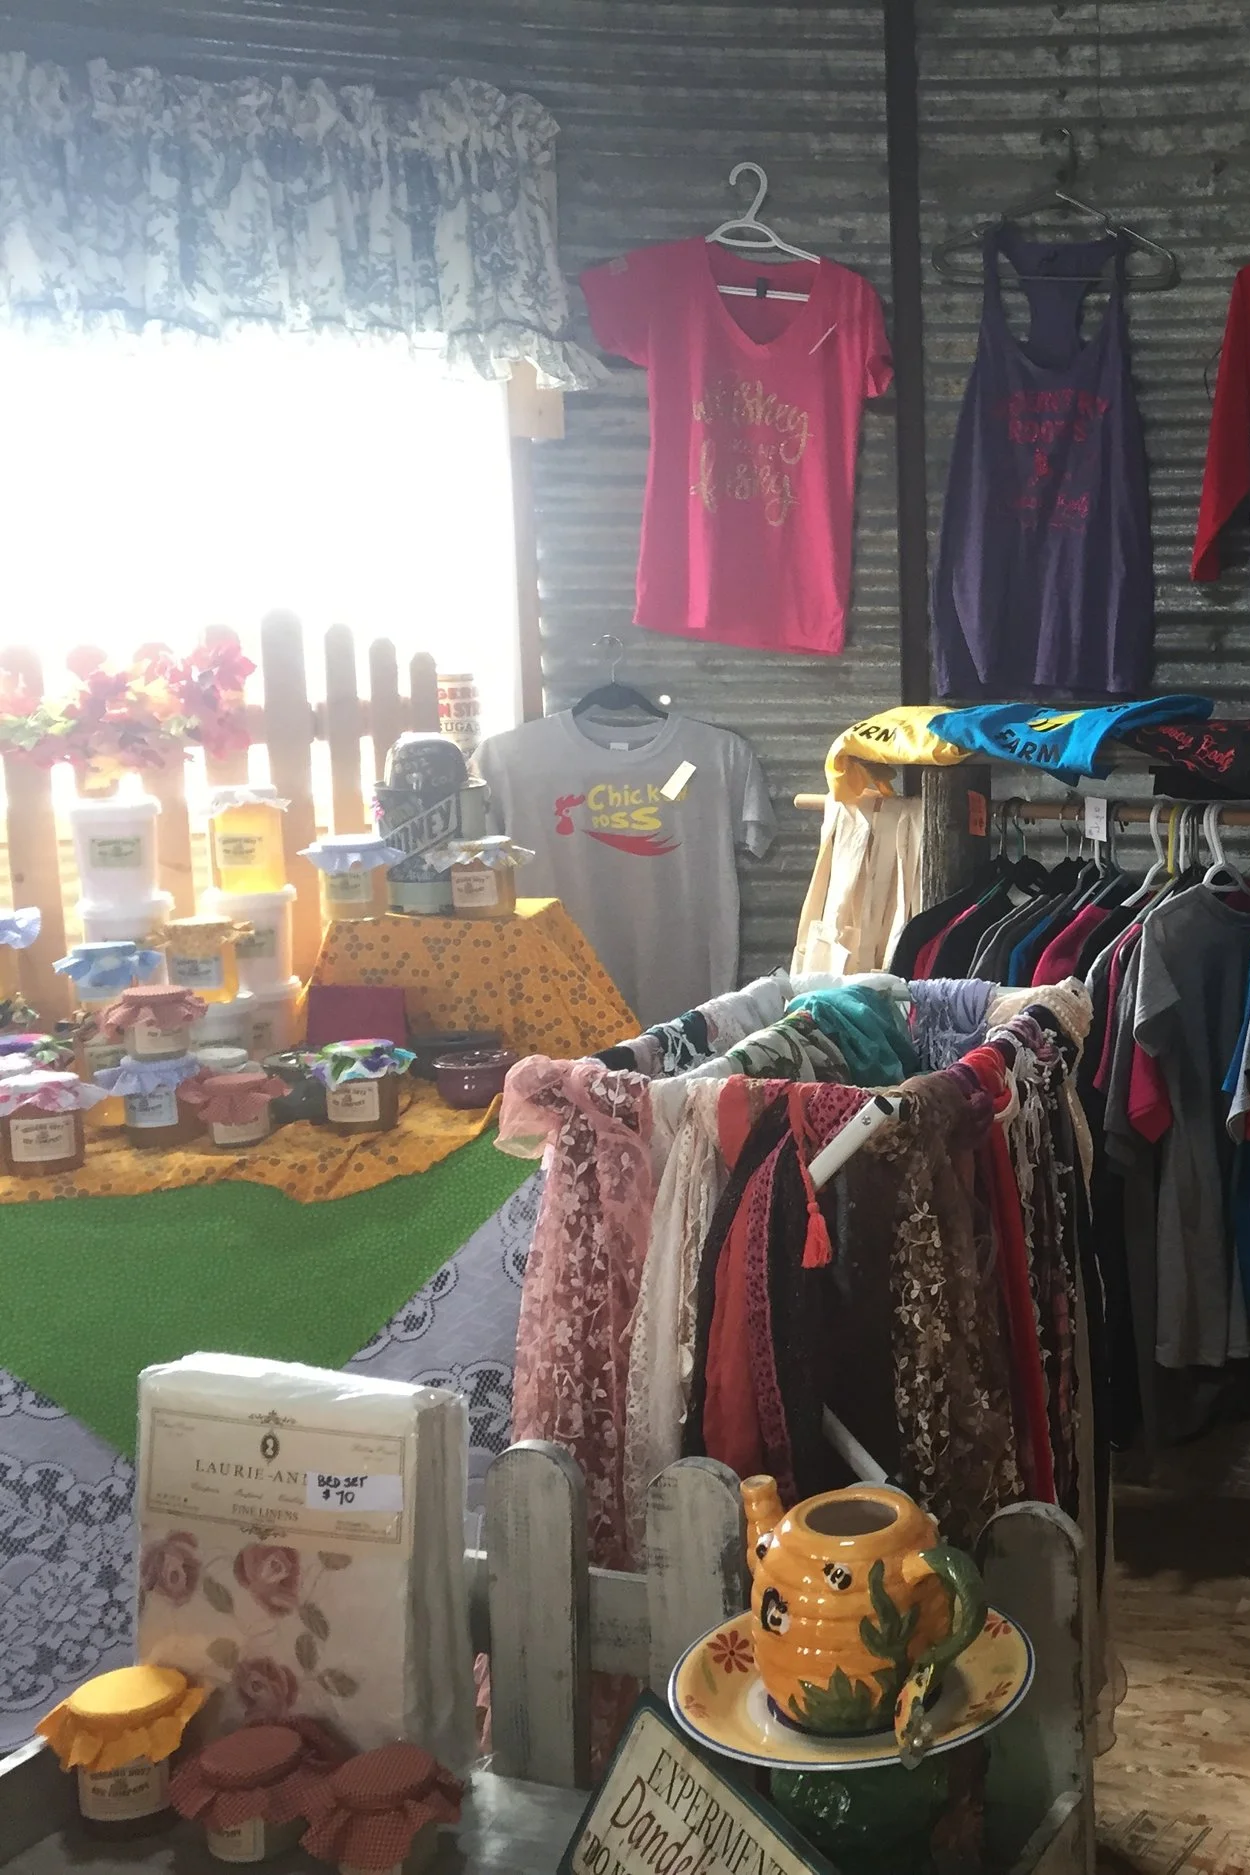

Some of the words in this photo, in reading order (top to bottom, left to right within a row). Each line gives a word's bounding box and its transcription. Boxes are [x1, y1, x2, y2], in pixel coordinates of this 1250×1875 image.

[997, 728, 1062, 763] FARM
[195, 1459, 308, 1486] LAURIE-AN
[317, 1475, 341, 1488] BED
[343, 1475, 368, 1487] SET
[231, 1503, 257, 1517] FINE
[258, 1506, 299, 1521] LINENS
